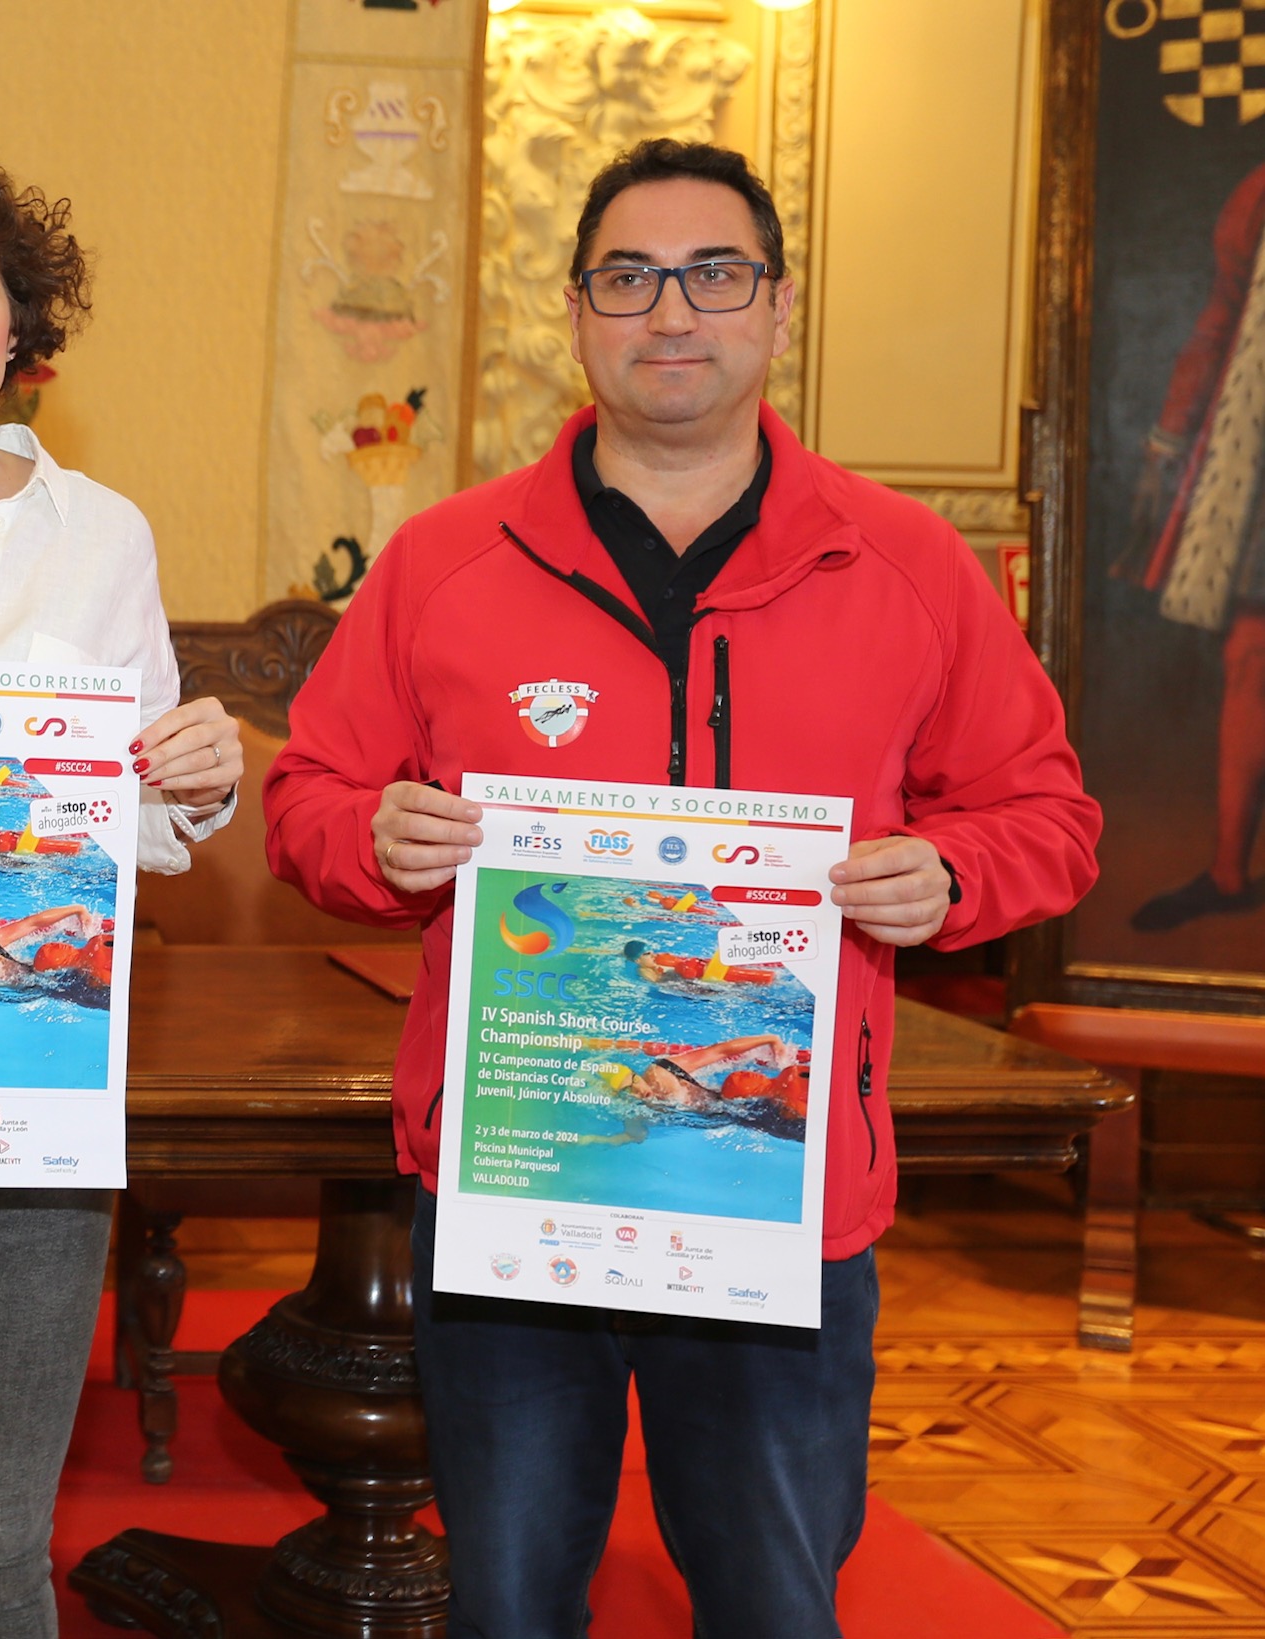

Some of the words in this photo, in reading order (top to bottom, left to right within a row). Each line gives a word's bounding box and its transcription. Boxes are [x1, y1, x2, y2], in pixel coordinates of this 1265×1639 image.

[526, 685, 581, 694] FECLESS
[54, 761, 92, 772] #SSCC24
[485, 785, 635, 808] SALVAMENTO
[649, 797, 660, 810] Y
[671, 799, 827, 820] SOCORRISMO
[37, 811, 88, 833] ahogados
[745, 889, 787, 901] #SSCC24
[727, 938, 782, 963] ahogados
[494, 968, 578, 1000] SSCC
[481, 1006, 497, 1021] IV
[499, 1007, 555, 1027] Spanish
[558, 1012, 598, 1031] Short
[600, 1015, 651, 1034] Course
[480, 1027, 583, 1053] Championship
[479, 1051, 491, 1063] IV
[492, 1052, 561, 1069] Campeonato
[563, 1058, 578, 1070] de
[579, 1059, 620, 1076] España
[477, 1067, 491, 1079] de
[494, 1068, 548, 1084] Distancias
[550, 1073, 587, 1088] Cortas
[475, 1083, 516, 1099] Juvenil,
[517, 1086, 552, 1101] Júnior
[553, 1092, 560, 1104] y
[562, 1090, 612, 1105] Absoluto
[475, 1124, 481, 1134] 2
[482, 1127, 488, 1137] y
[490, 1125, 496, 1136] 3
[497, 1126, 510, 1137] de
[511, 1129, 540, 1139] marzo
[541, 1129, 554, 1141] de
[555, 1131, 579, 1142] 2024
[474, 1141, 506, 1154] Piscina
[506, 1143, 553, 1160] Municipal
[42, 1155, 79, 1167] Safely
[473, 1155, 513, 1168] Cubierta
[513, 1158, 560, 1173] Parquesol
[472, 1172, 529, 1187] VALLADOLID
[604, 1274, 643, 1287] SQUALI
[727, 1287, 768, 1301] Safely
